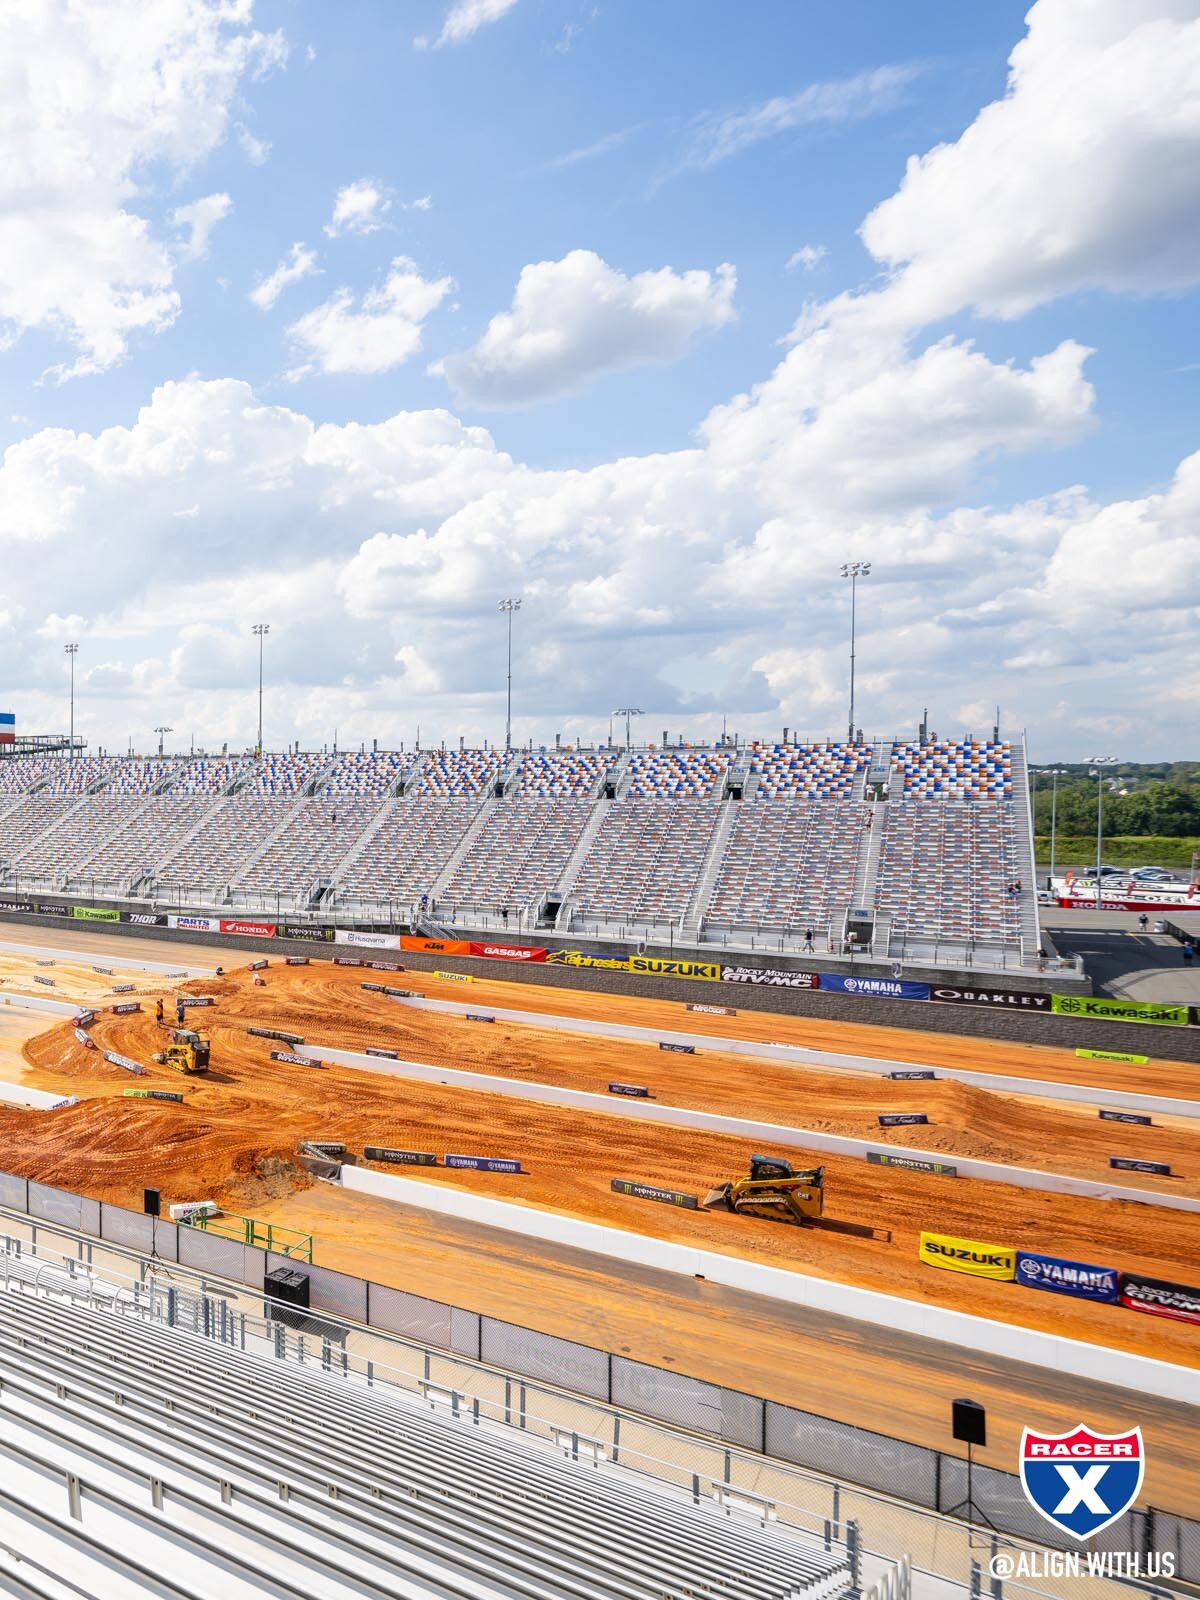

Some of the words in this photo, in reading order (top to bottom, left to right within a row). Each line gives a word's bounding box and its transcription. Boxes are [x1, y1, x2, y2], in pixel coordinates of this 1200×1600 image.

[85, 911, 117, 921] Kawasaki
[129, 914, 158, 924] THOR
[177, 917, 210, 926] PARTS
[236, 926, 269, 934] HONDA
[288, 928, 322, 937] MONSTER
[354, 935, 386, 944] Husqvarna
[484, 947, 531, 958] GASGAS
[568, 955, 629, 970] alpinestars
[633, 959, 717, 978] SUZUKI
[736, 967, 764, 976] ROCKY
[764, 969, 812, 980] MOUNTAIN
[438, 973, 468, 982] SUZUKI
[857, 980, 903, 993] YAMAHA
[963, 991, 1047, 1007] OAKLEY
[1086, 1002, 1179, 1022] Kawasaki
[1092, 1052, 1134, 1063] Kawasaki
[384, 1151, 416, 1161] MONSTER
[456, 1158, 478, 1167] YAMAHA
[890, 1158, 931, 1170] MONSTER
[634, 1187, 672, 1200] MONSTER
[925, 1242, 1011, 1269] SUZUKI
[1041, 1263, 1114, 1290] YAMAHA
